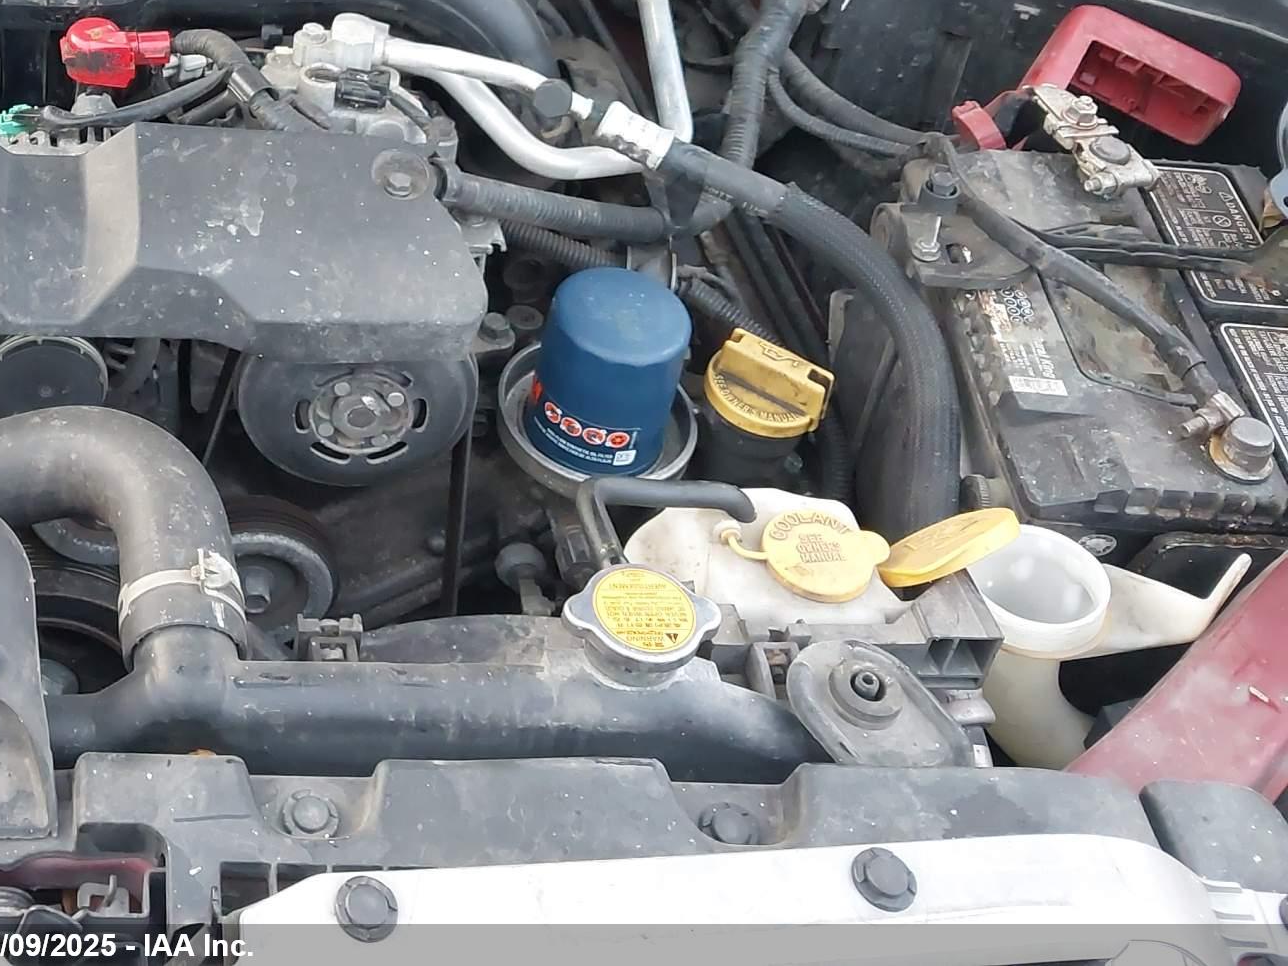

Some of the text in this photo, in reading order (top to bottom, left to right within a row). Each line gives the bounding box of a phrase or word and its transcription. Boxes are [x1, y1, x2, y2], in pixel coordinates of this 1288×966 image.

[1039, 357, 1056, 379] King
[769, 512, 850, 541] COOLANT
[798, 534, 824, 544] SEE
[799, 552, 847, 563] MANUAL
